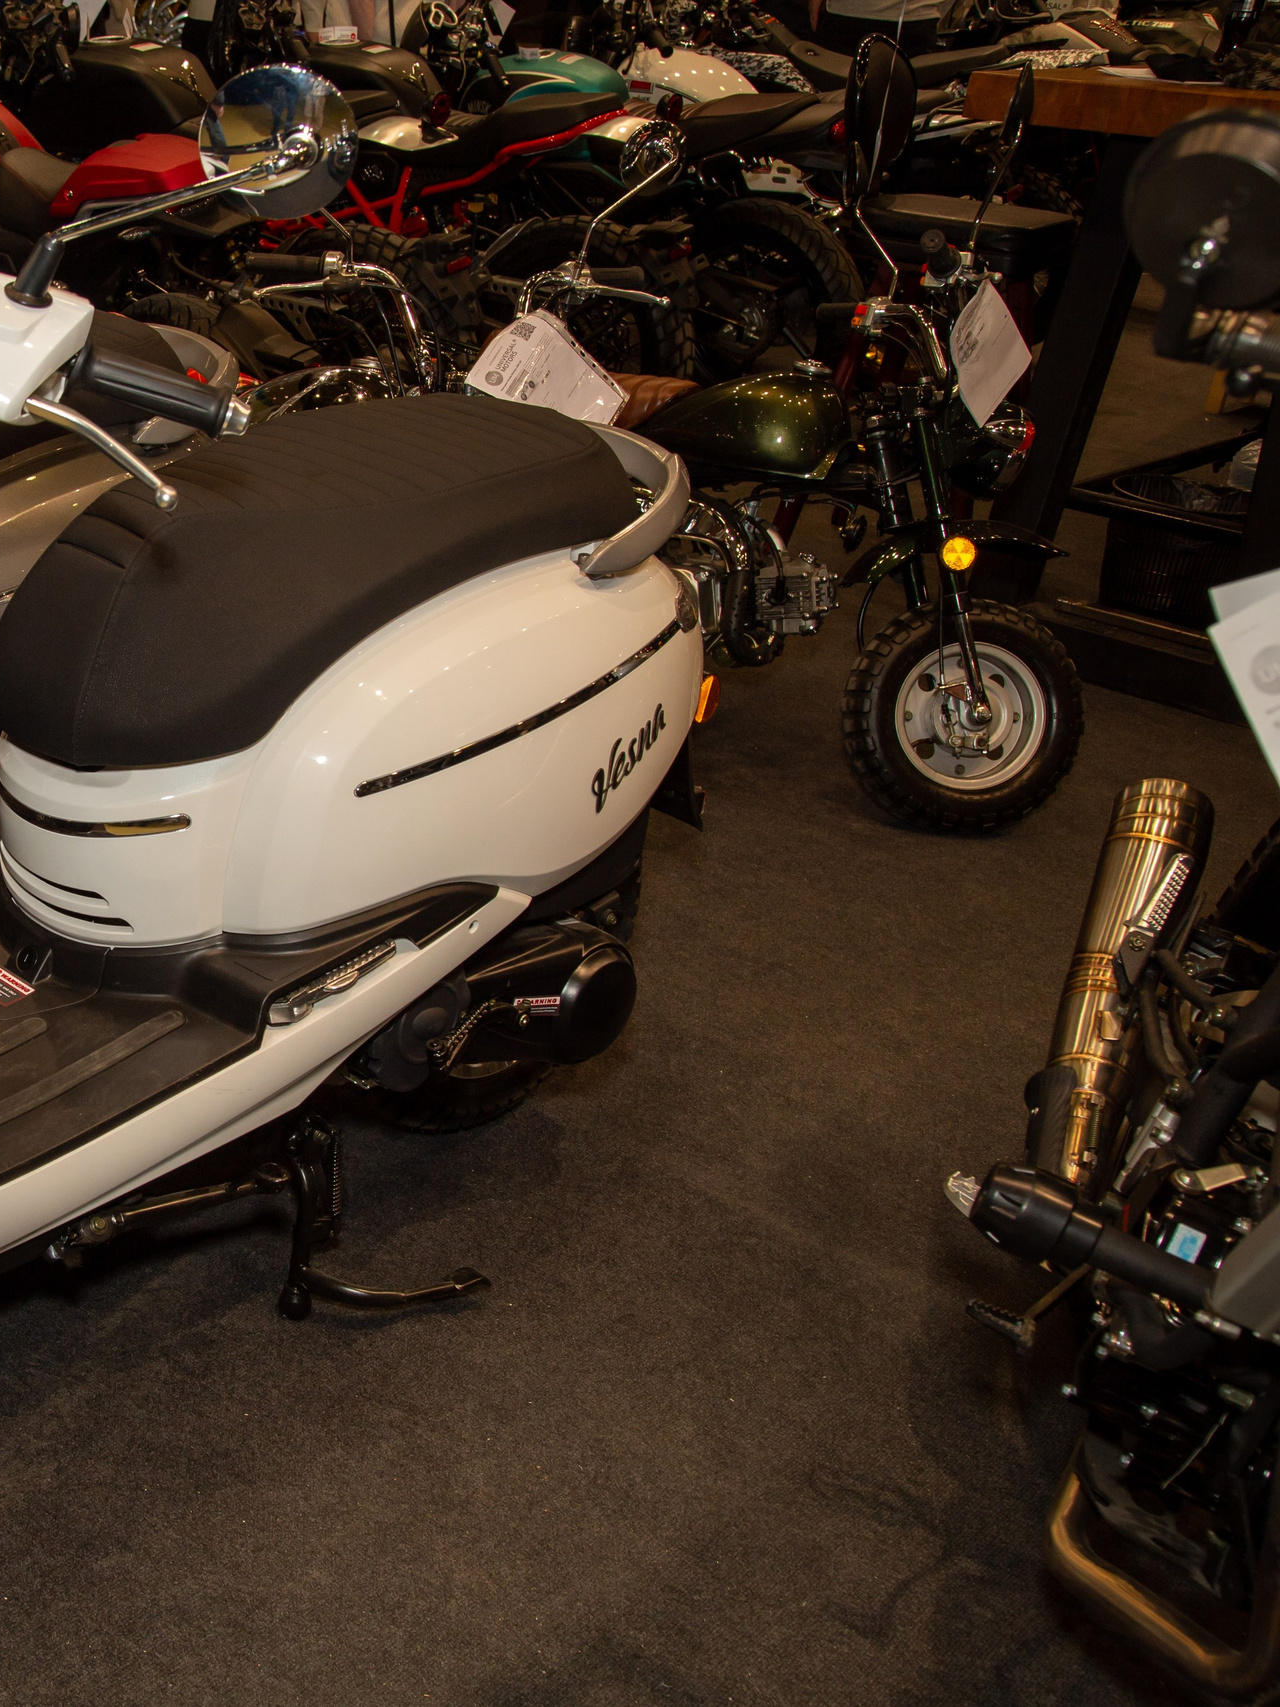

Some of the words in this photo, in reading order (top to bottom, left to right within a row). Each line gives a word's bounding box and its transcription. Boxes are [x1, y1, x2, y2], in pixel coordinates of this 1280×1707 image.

[501, 351, 518, 373] MOTORS
[591, 703, 666, 814] Vesna
[0, 973, 31, 992] WARNING
